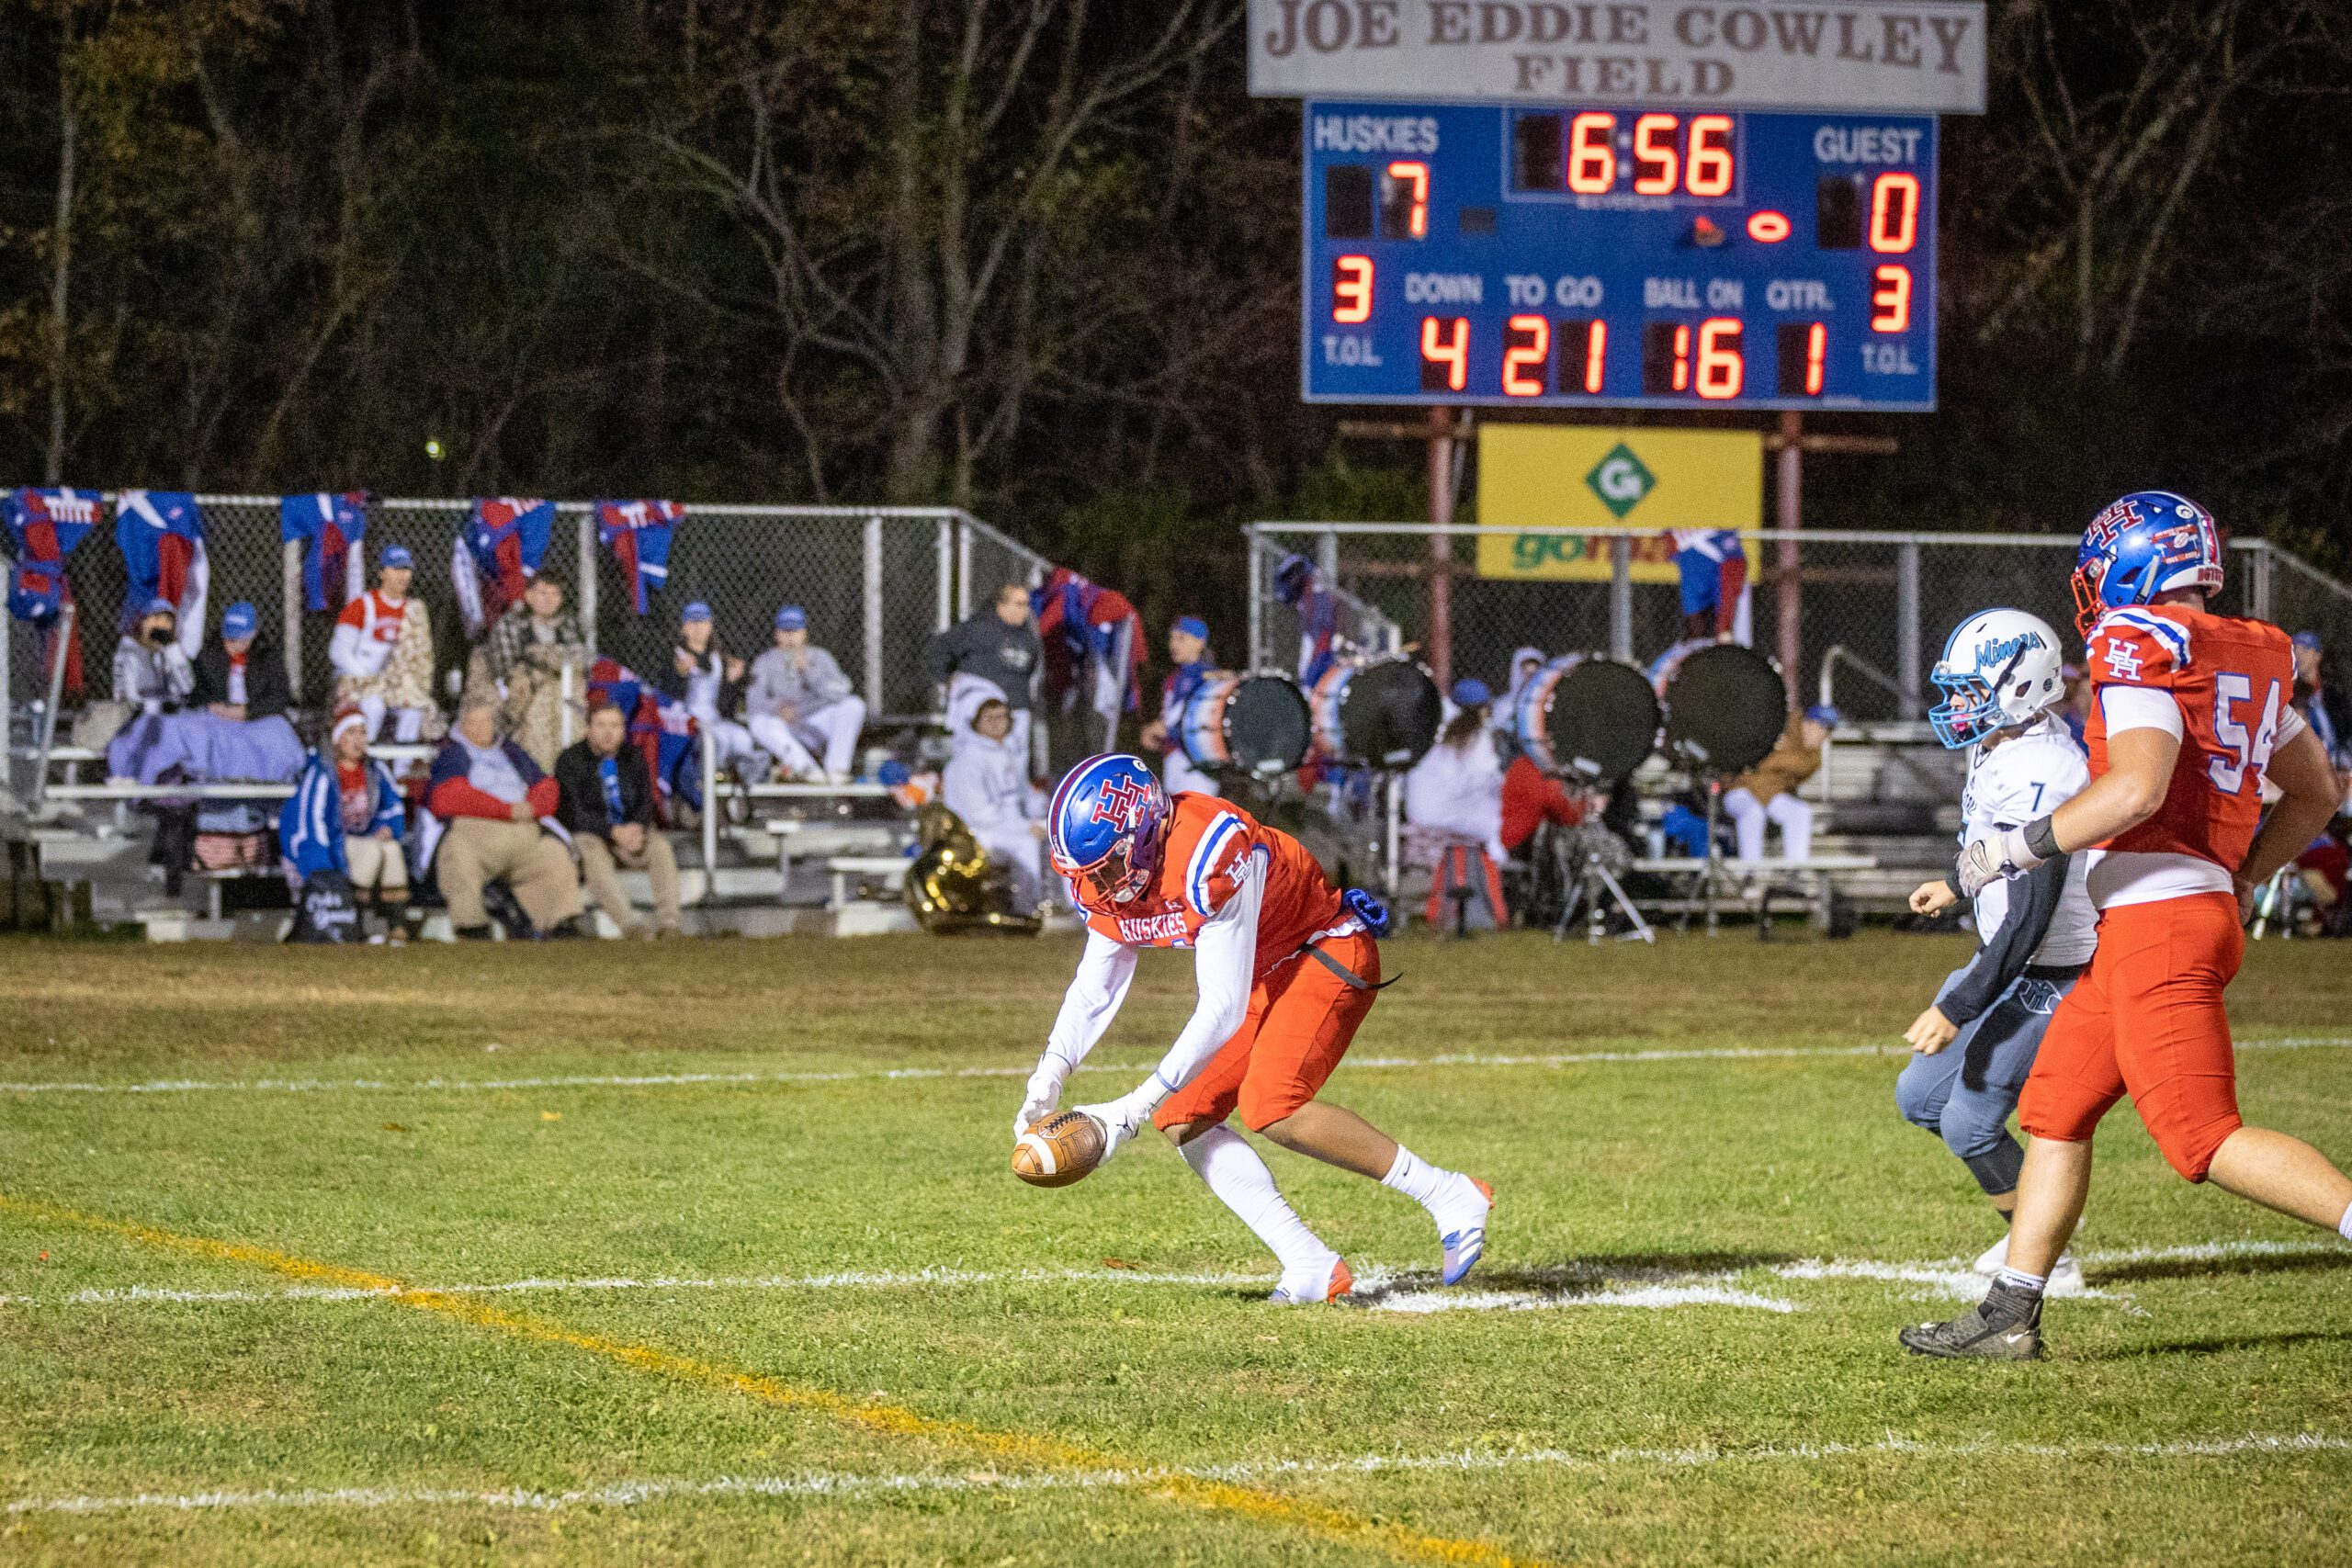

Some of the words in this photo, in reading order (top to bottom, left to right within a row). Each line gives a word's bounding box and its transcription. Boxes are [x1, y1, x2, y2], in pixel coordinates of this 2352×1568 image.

[1265, 0, 1399, 57] JOE
[1427, 0, 1649, 45] EDDIE
[1674, 6, 1971, 75] COWLEY
[1512, 52, 1735, 95] FIELD
[1314, 115, 1440, 154] HUSKIES
[1568, 111, 1735, 197] 6:56
[1813, 125, 1923, 164] GUEST
[1386, 161, 1430, 237] 7
[1869, 172, 1920, 254] 0
[1332, 254, 1374, 323] 3
[1405, 273, 1484, 304] DOWN
[1504, 275, 1548, 307] TO
[1555, 276, 1605, 308] GO
[1643, 276, 1700, 309] BALL
[1706, 278, 1744, 310] ON
[1871, 264, 1912, 333] 3
[1420, 315, 1470, 391] 4
[1671, 316, 1744, 400] 16
[1804, 321, 1828, 397] 1
[1600, 458, 1641, 499] G
[1974, 631, 2041, 675] Miners
[2208, 671, 2280, 795] 54
[2029, 781, 2047, 813] 7
[1119, 911, 1188, 942] HUSKIES
